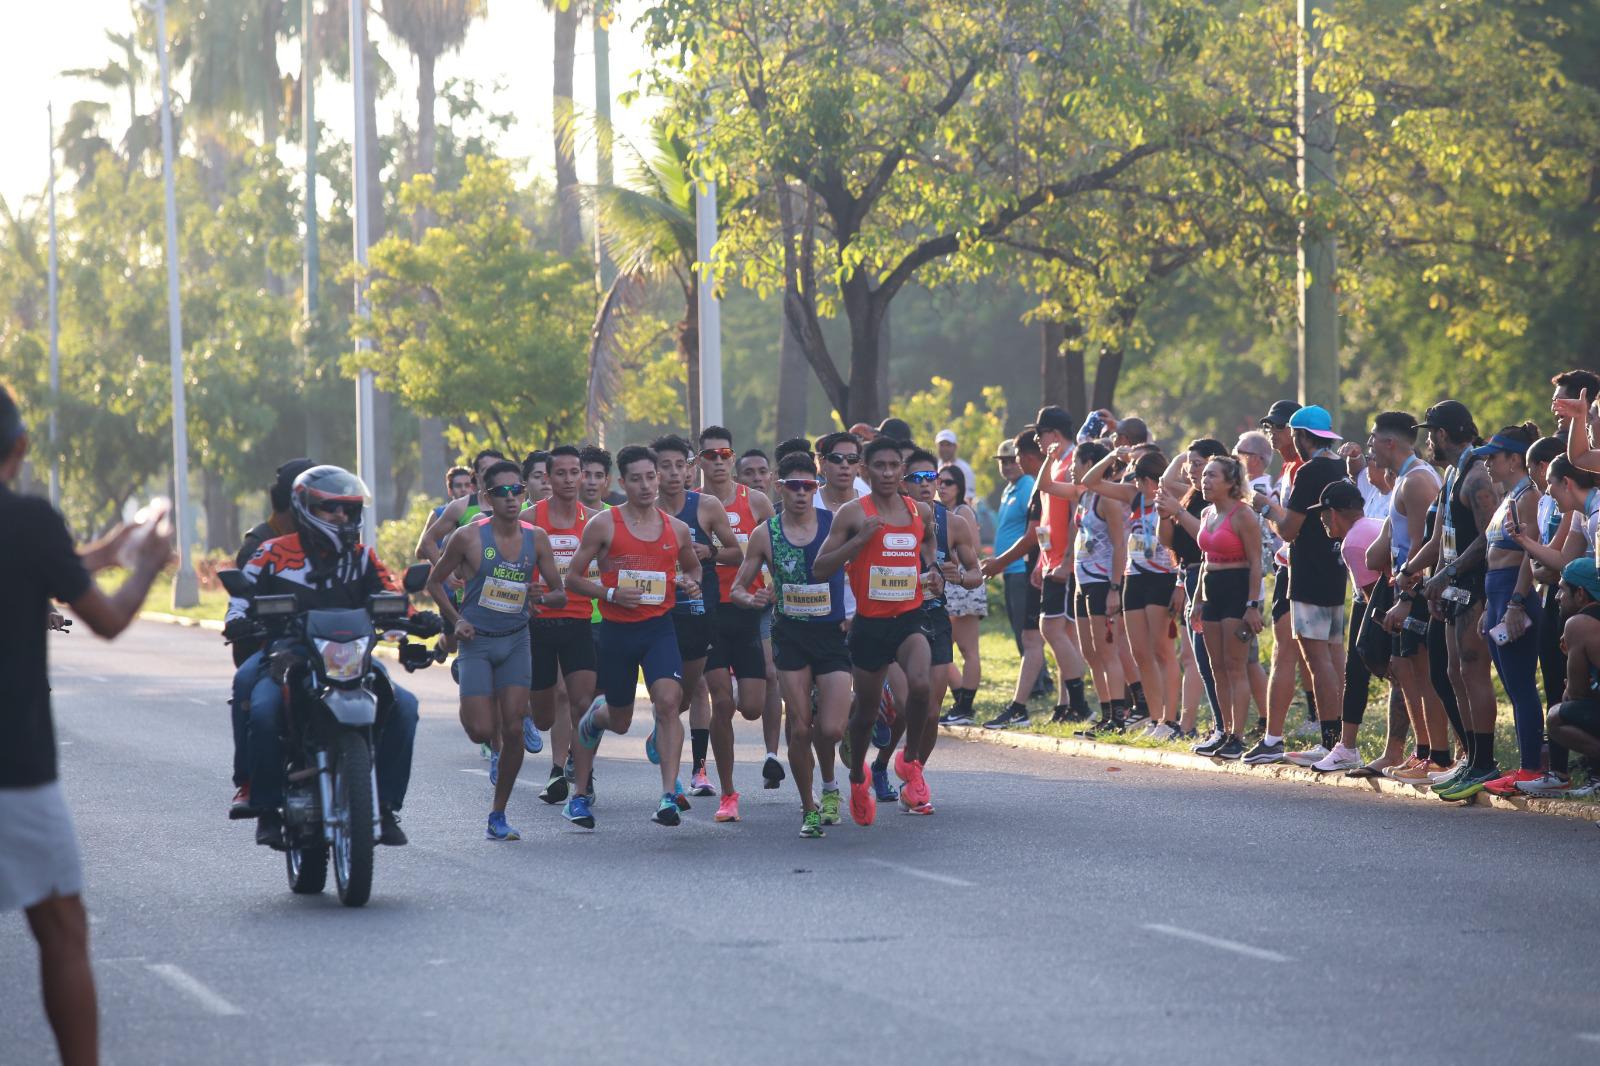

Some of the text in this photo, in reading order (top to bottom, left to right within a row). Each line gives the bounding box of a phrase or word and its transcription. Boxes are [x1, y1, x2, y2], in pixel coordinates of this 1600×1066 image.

[493, 566, 525, 582] MEXICO
[635, 579, 652, 594] 154
[889, 579, 908, 587] REYES
